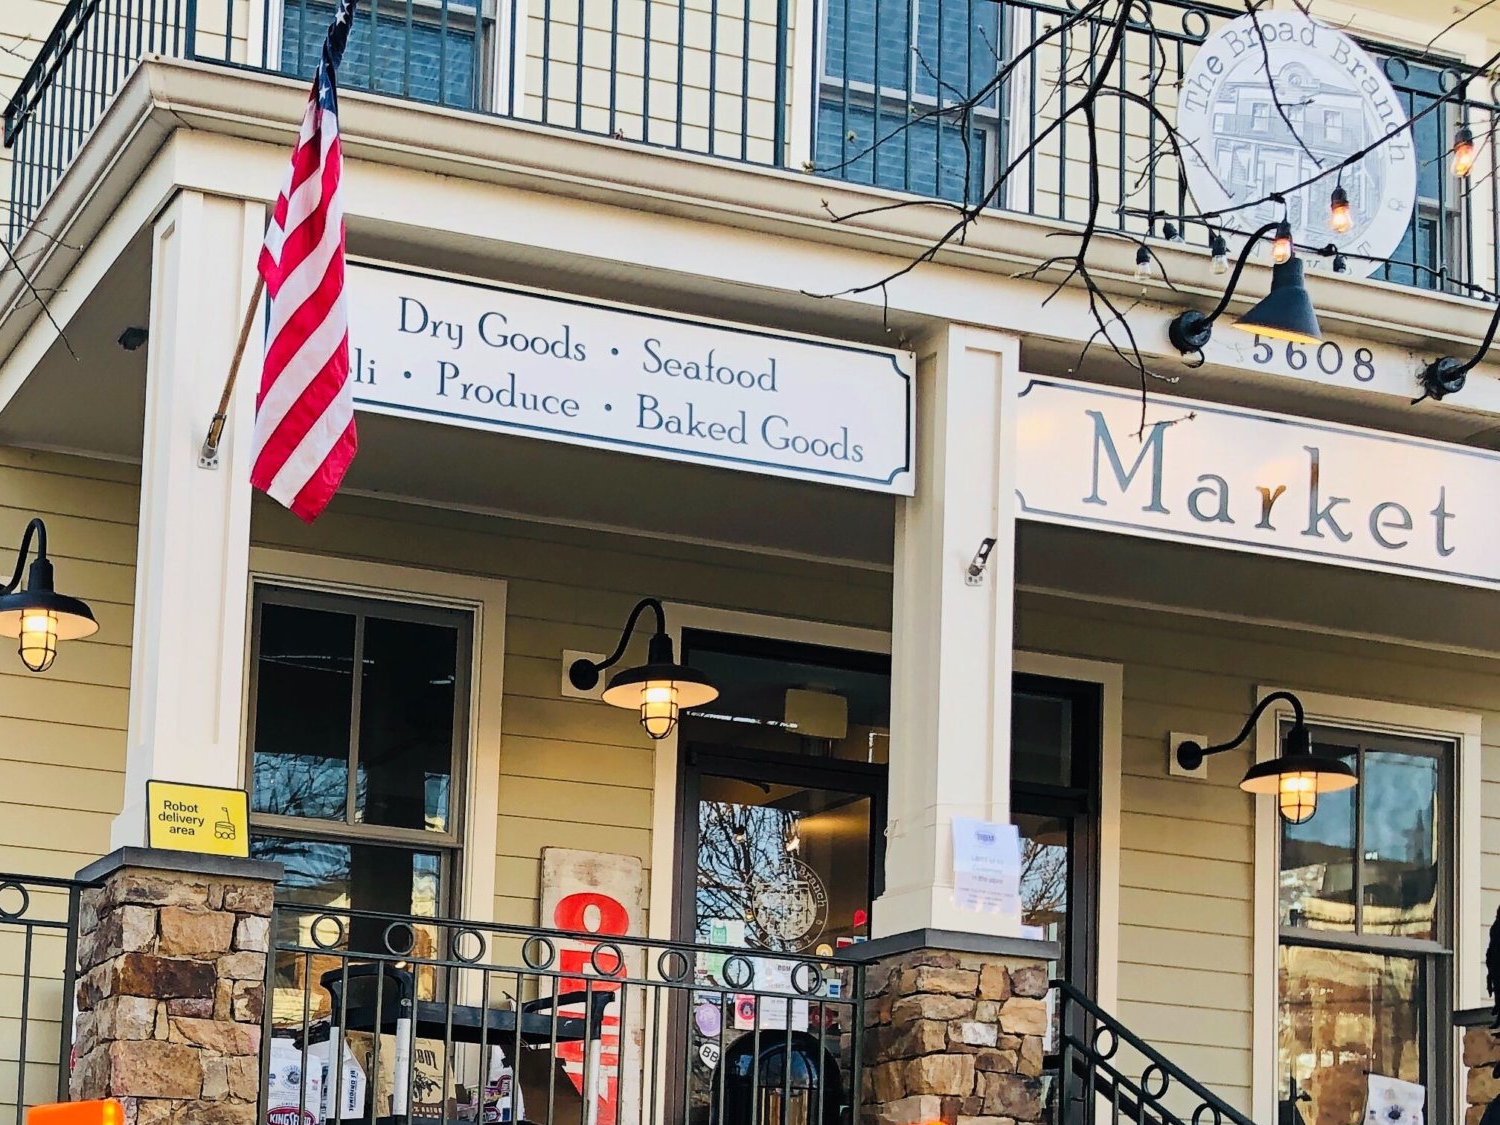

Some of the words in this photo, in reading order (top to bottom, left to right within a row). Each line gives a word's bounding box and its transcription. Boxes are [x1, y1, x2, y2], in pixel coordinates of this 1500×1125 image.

[1184, 54, 1224, 115] The
[1221, 20, 1318, 59] Broad
[1330, 36, 1411, 165] Branch
[398, 296, 464, 350] Dry
[478, 311, 587, 362] Goods
[642, 338, 779, 392] Seafood
[1253, 334, 1376, 383] 5608
[436, 360, 581, 418] Produce
[636, 394, 748, 446] Baked
[761, 415, 865, 464] Goods
[1081, 408, 1456, 558] Market
[158, 811, 205, 827] delivery
[163, 800, 198, 813] Robot
[169, 826, 195, 836] area
[701, 1046, 719, 1063] BB
